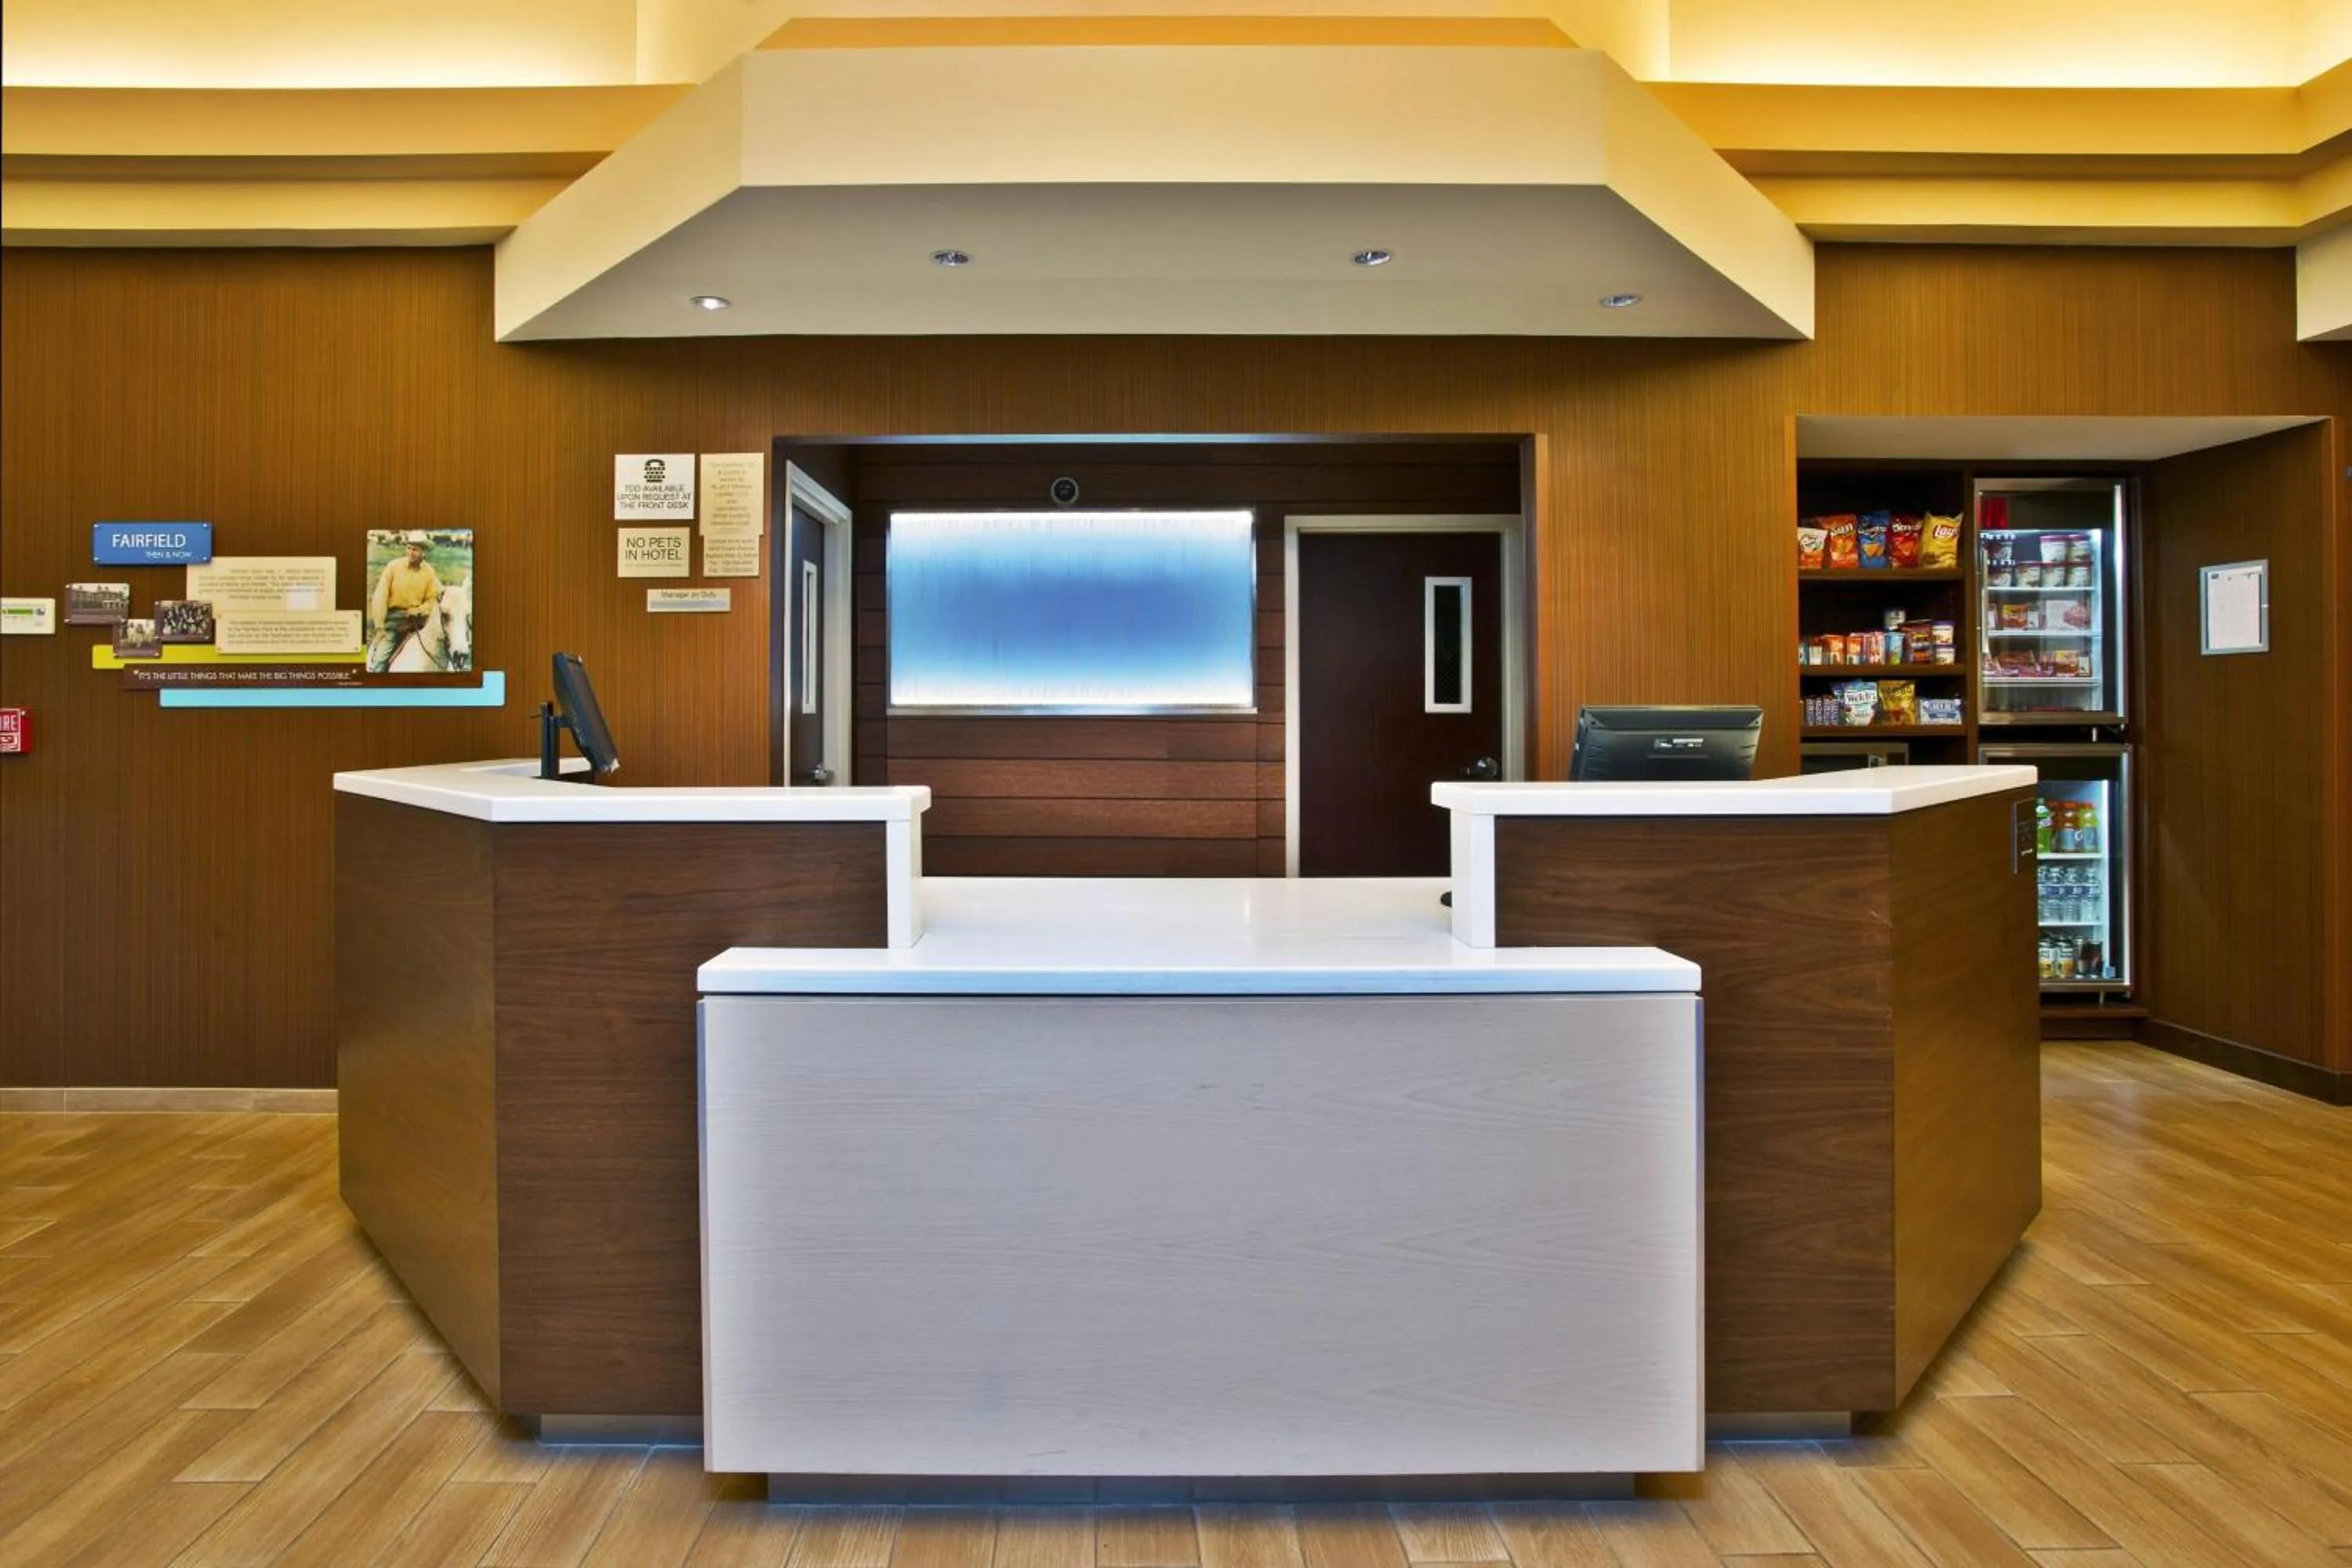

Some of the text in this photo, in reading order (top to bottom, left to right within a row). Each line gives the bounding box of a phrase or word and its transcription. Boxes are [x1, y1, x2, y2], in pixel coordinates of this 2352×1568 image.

[112, 534, 187, 548] FAIRFIELD
[626, 537, 681, 548] NO PETS
[625, 549, 684, 560] IN HOTEL
[153, 672, 166, 681] THE
[168, 672, 189, 681] LITTLE
[191, 672, 217, 681] THINGS
[219, 672, 236, 681] THAT
[0, 714, 18, 731] IRE
